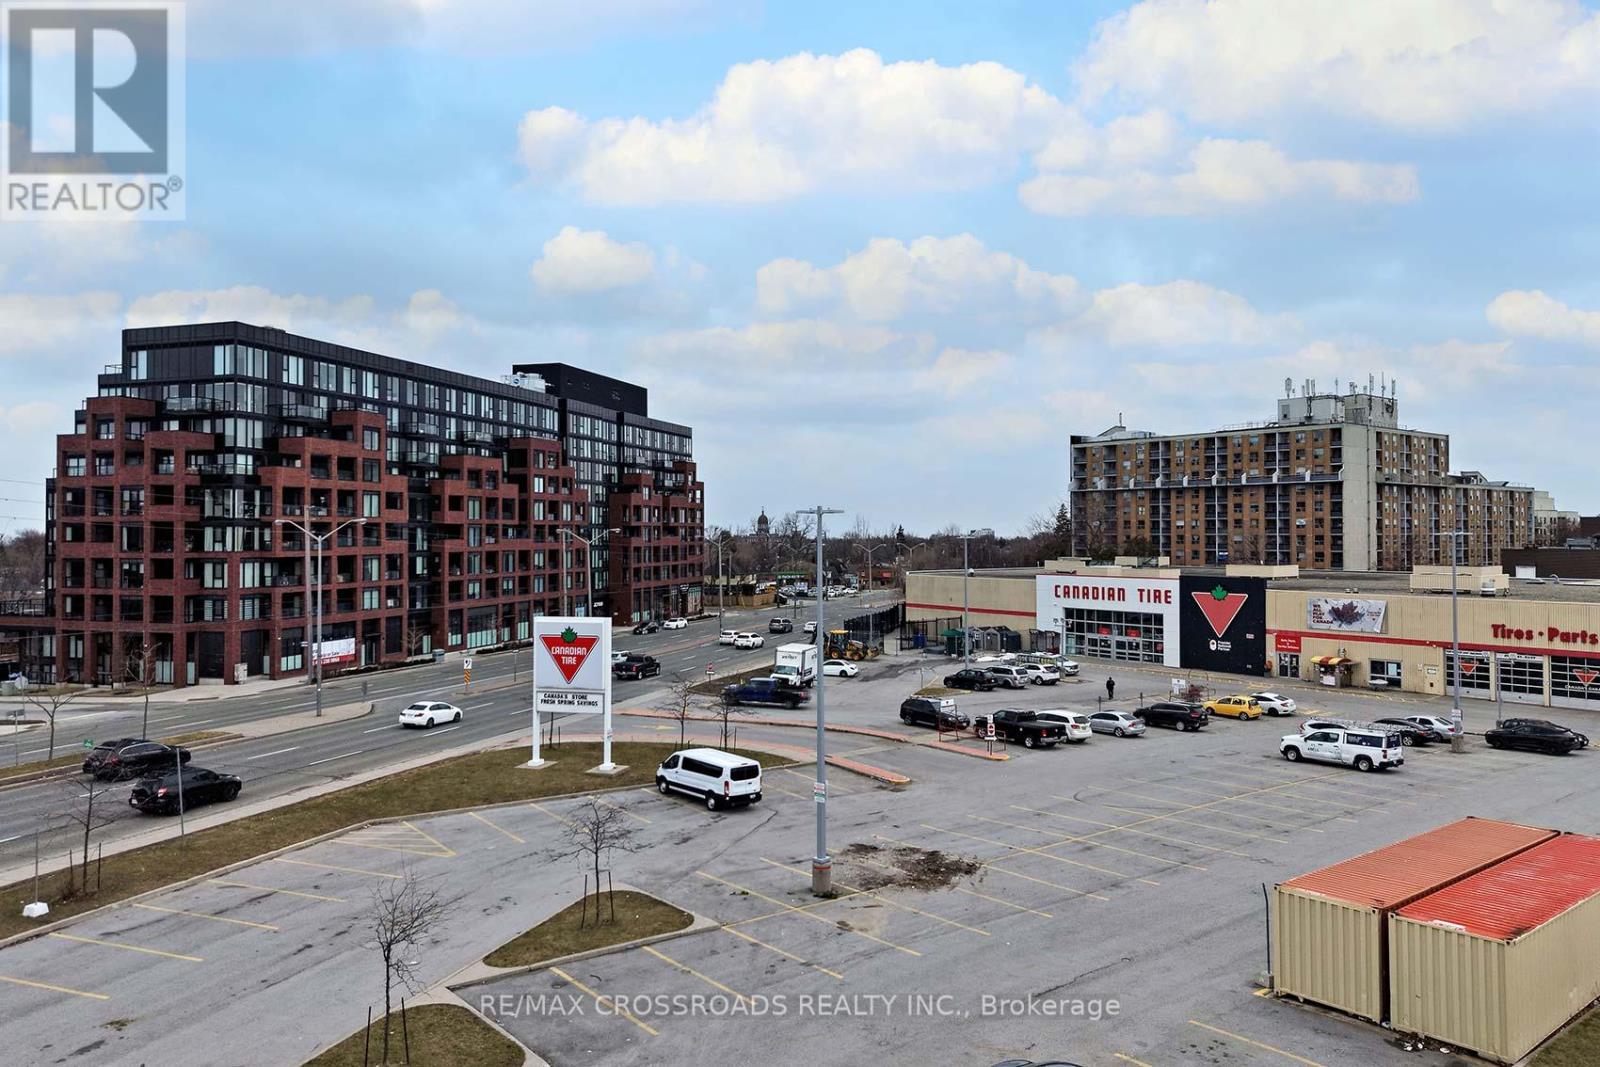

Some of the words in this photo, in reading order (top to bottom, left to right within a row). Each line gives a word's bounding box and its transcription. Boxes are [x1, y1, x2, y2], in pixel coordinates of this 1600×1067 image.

[1054, 584, 1126, 602] CANADIAN
[1137, 588, 1172, 604] TIRE
[1491, 624, 1534, 641] Tires
[1547, 627, 1599, 645] Parts
[551, 646, 587, 655] CANADIAN
[561, 656, 577, 665] TIRE
